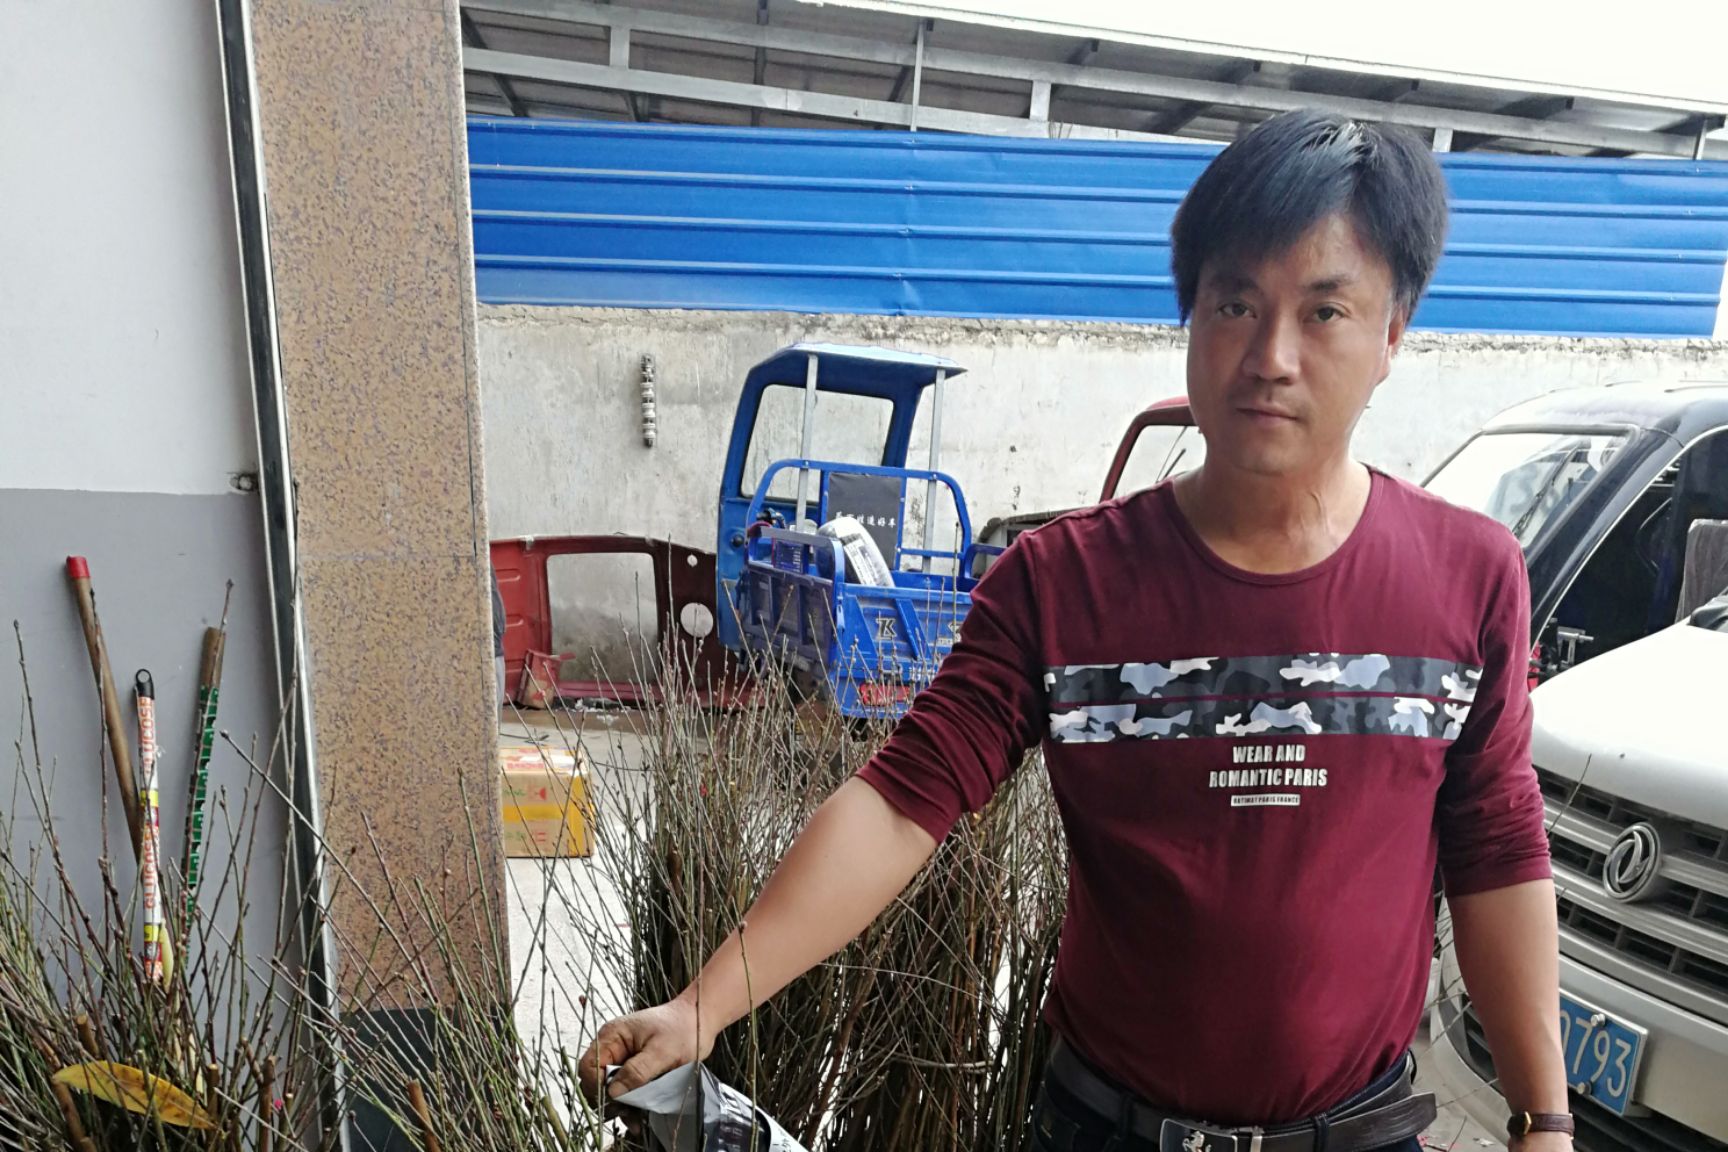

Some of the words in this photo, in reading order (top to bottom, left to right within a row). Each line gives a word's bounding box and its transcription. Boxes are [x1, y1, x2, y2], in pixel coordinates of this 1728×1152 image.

[1233, 746, 1273, 763] WEAR
[1275, 744, 1306, 762] AND
[1209, 768, 1282, 788] ROMANTIC
[1284, 768, 1328, 787] PARIS
